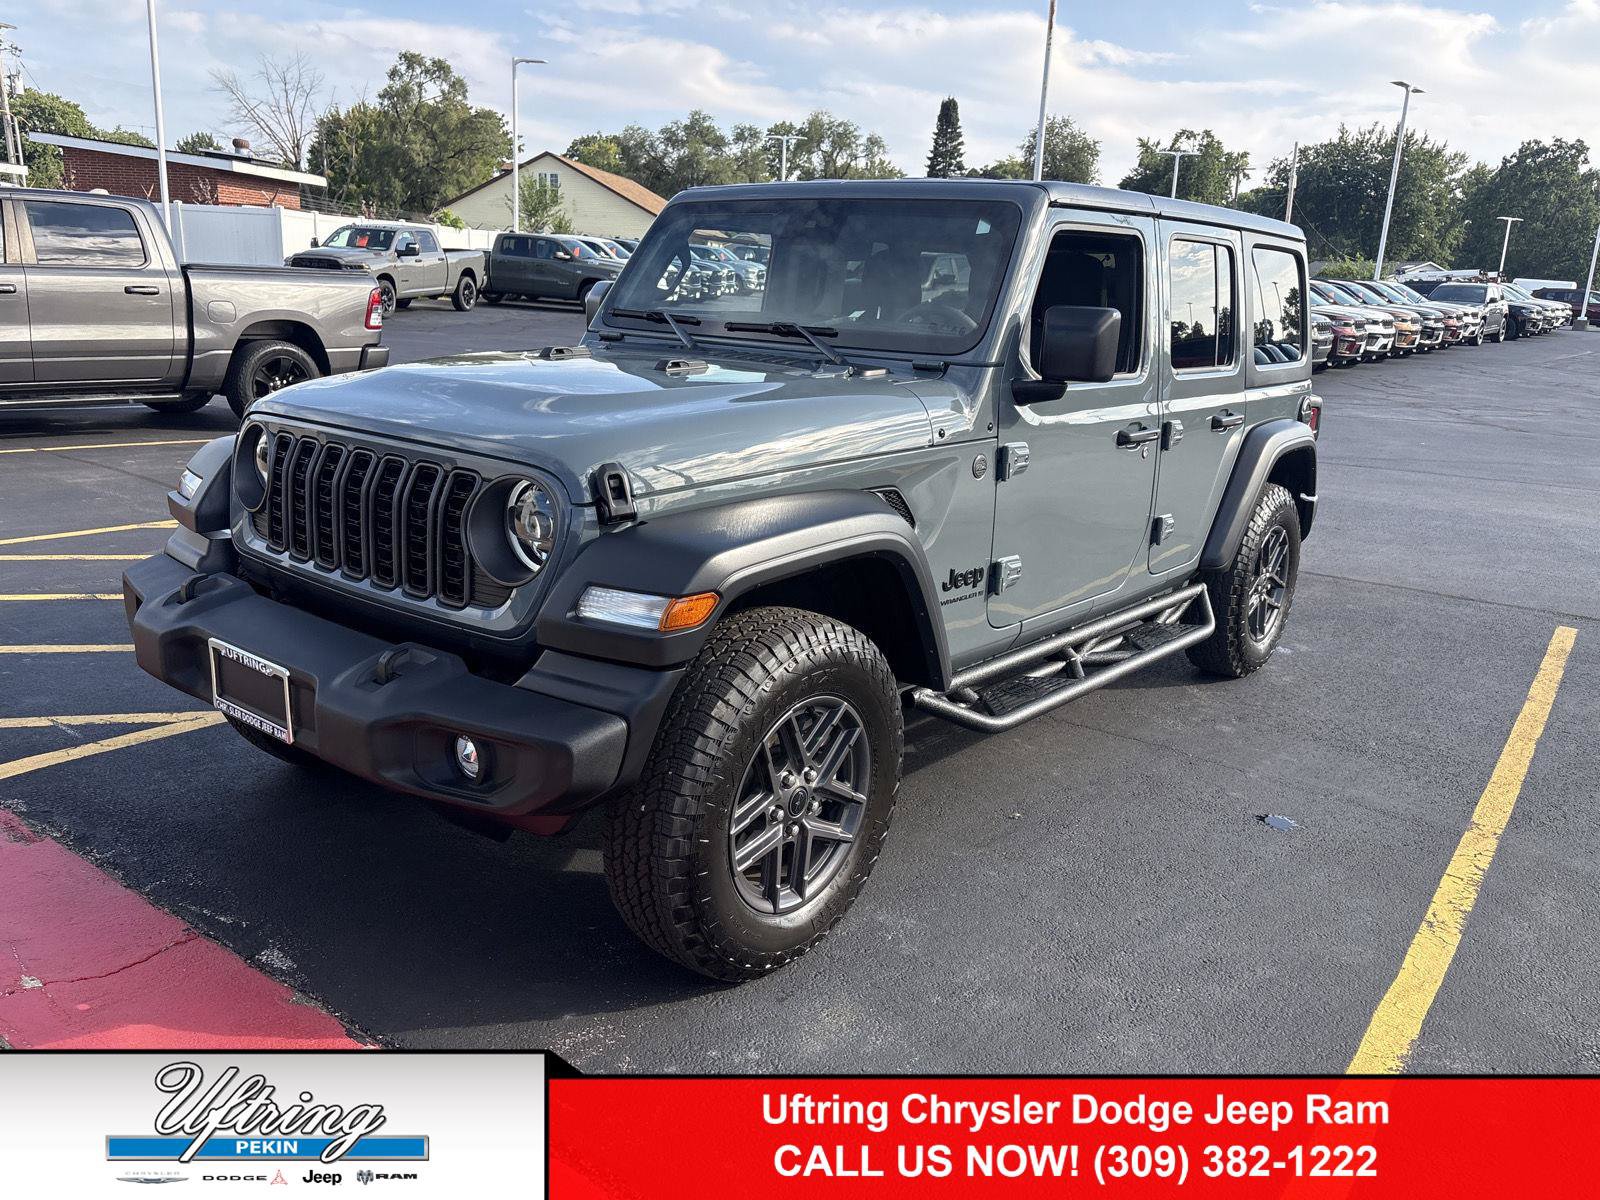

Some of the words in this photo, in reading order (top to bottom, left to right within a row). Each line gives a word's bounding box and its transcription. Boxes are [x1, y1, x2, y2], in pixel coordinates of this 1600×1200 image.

[942, 566, 984, 592] Jeep
[940, 591, 977, 606] WRANGLER
[226, 647, 267, 672] UFTRING
[242, 711, 261, 729] DODGE
